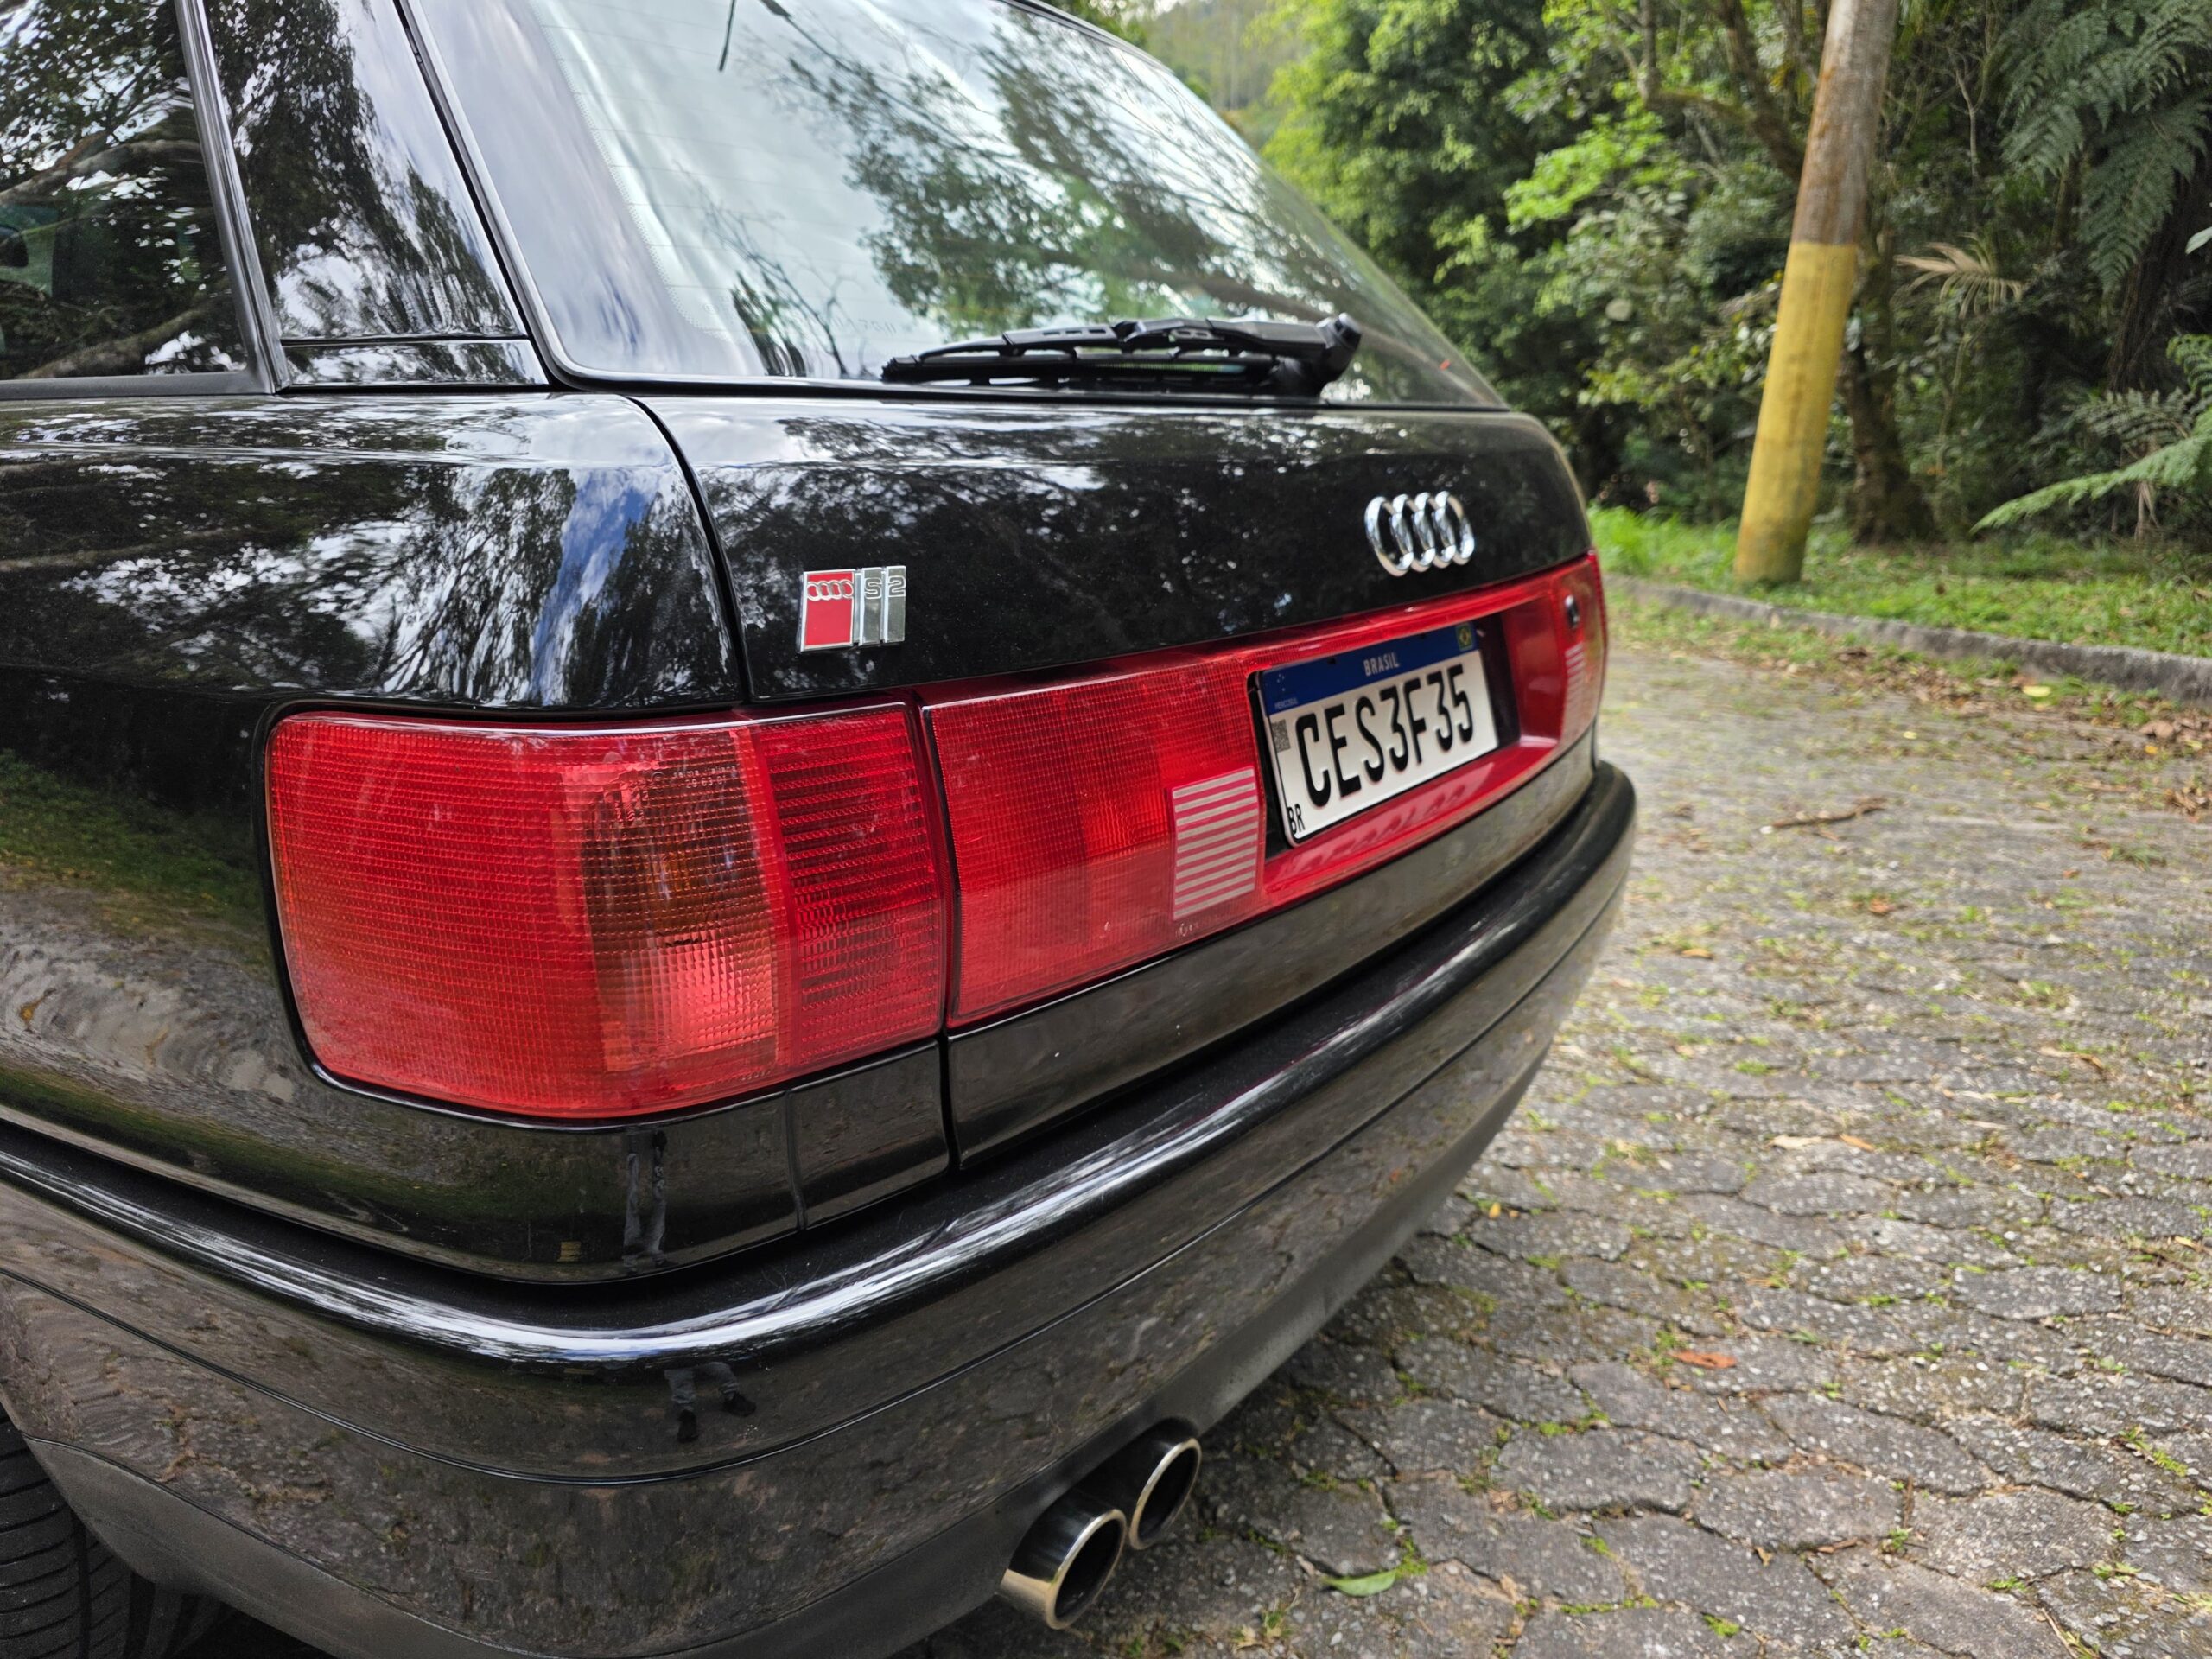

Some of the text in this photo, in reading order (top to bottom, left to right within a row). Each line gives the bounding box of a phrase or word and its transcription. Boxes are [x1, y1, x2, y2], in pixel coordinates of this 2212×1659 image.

[864, 575, 906, 600] S2
[1363, 652, 1400, 677] BRASIL
[1295, 664, 1474, 807] CES3F35
[1287, 804, 1306, 835] BR
